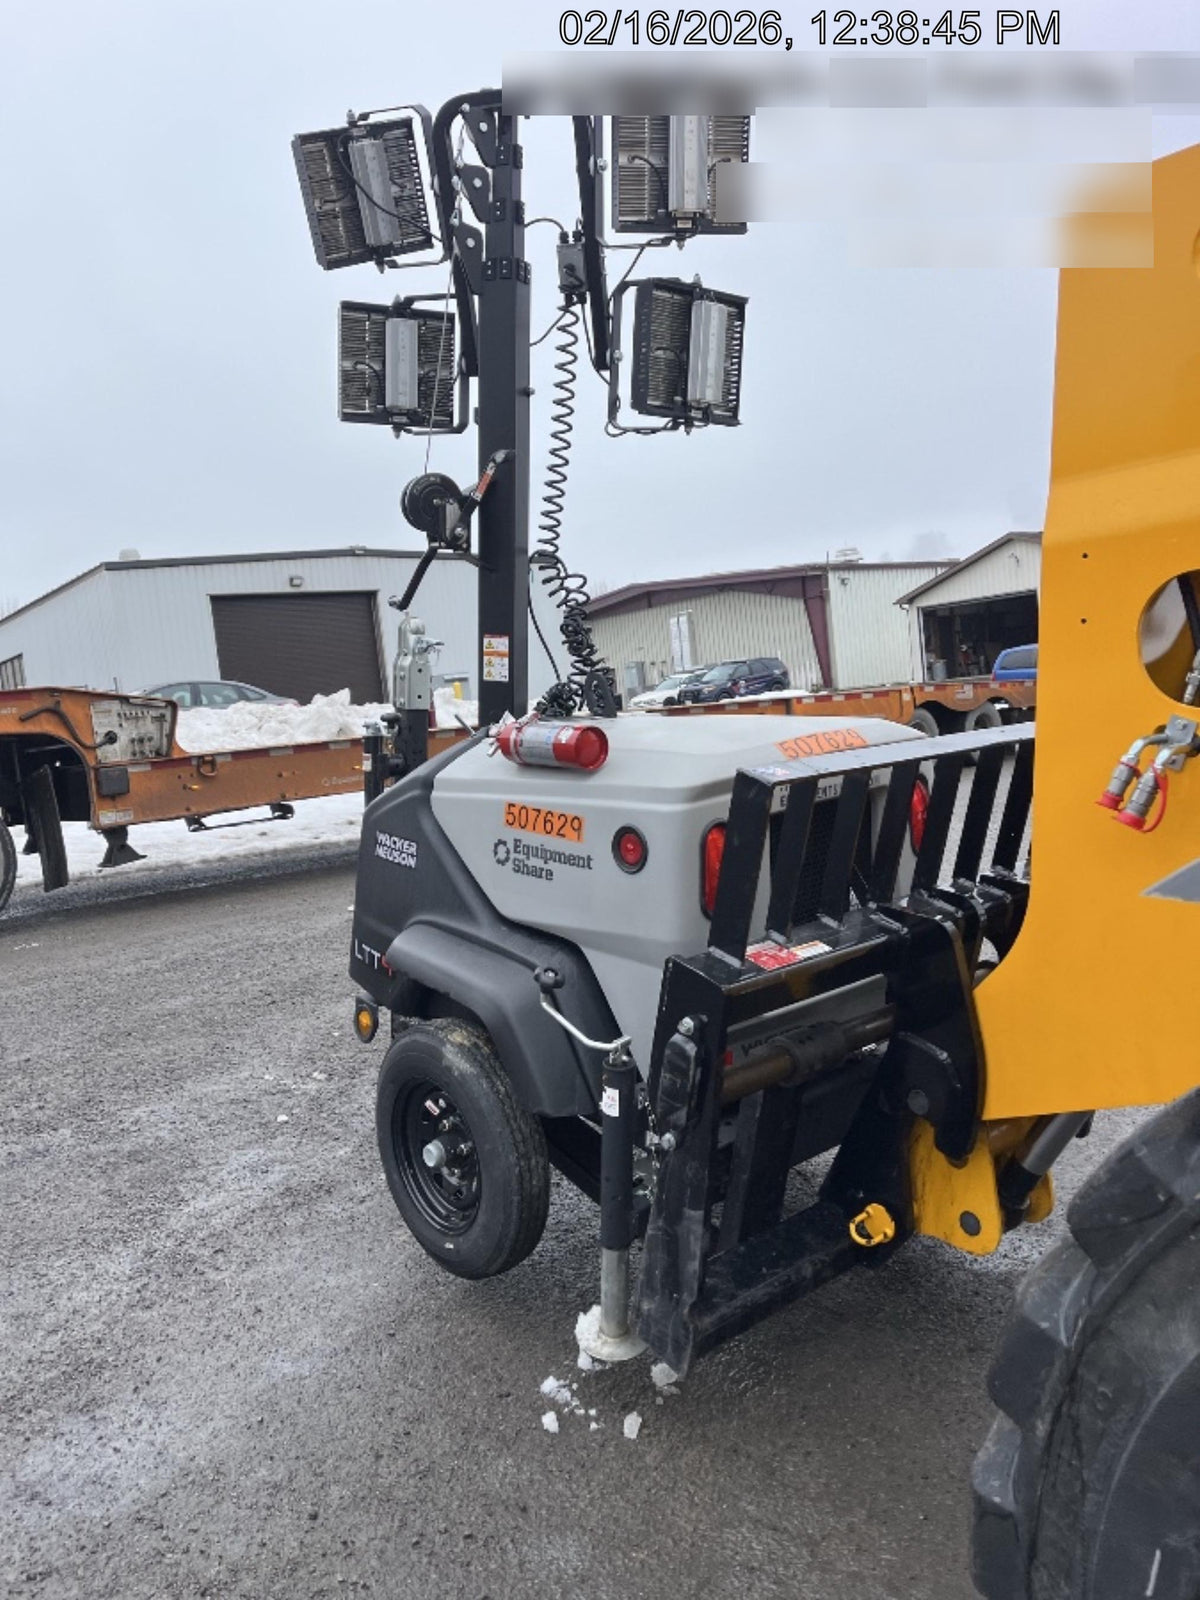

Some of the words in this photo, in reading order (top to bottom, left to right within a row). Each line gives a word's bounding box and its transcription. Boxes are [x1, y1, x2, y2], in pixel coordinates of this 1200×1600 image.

[505, 802, 583, 841] 507629
[374, 843, 418, 869] NEUSON
[376, 830, 418, 856] WACKER
[513, 838, 594, 870] Equipment
[512, 857, 554, 881] Share
